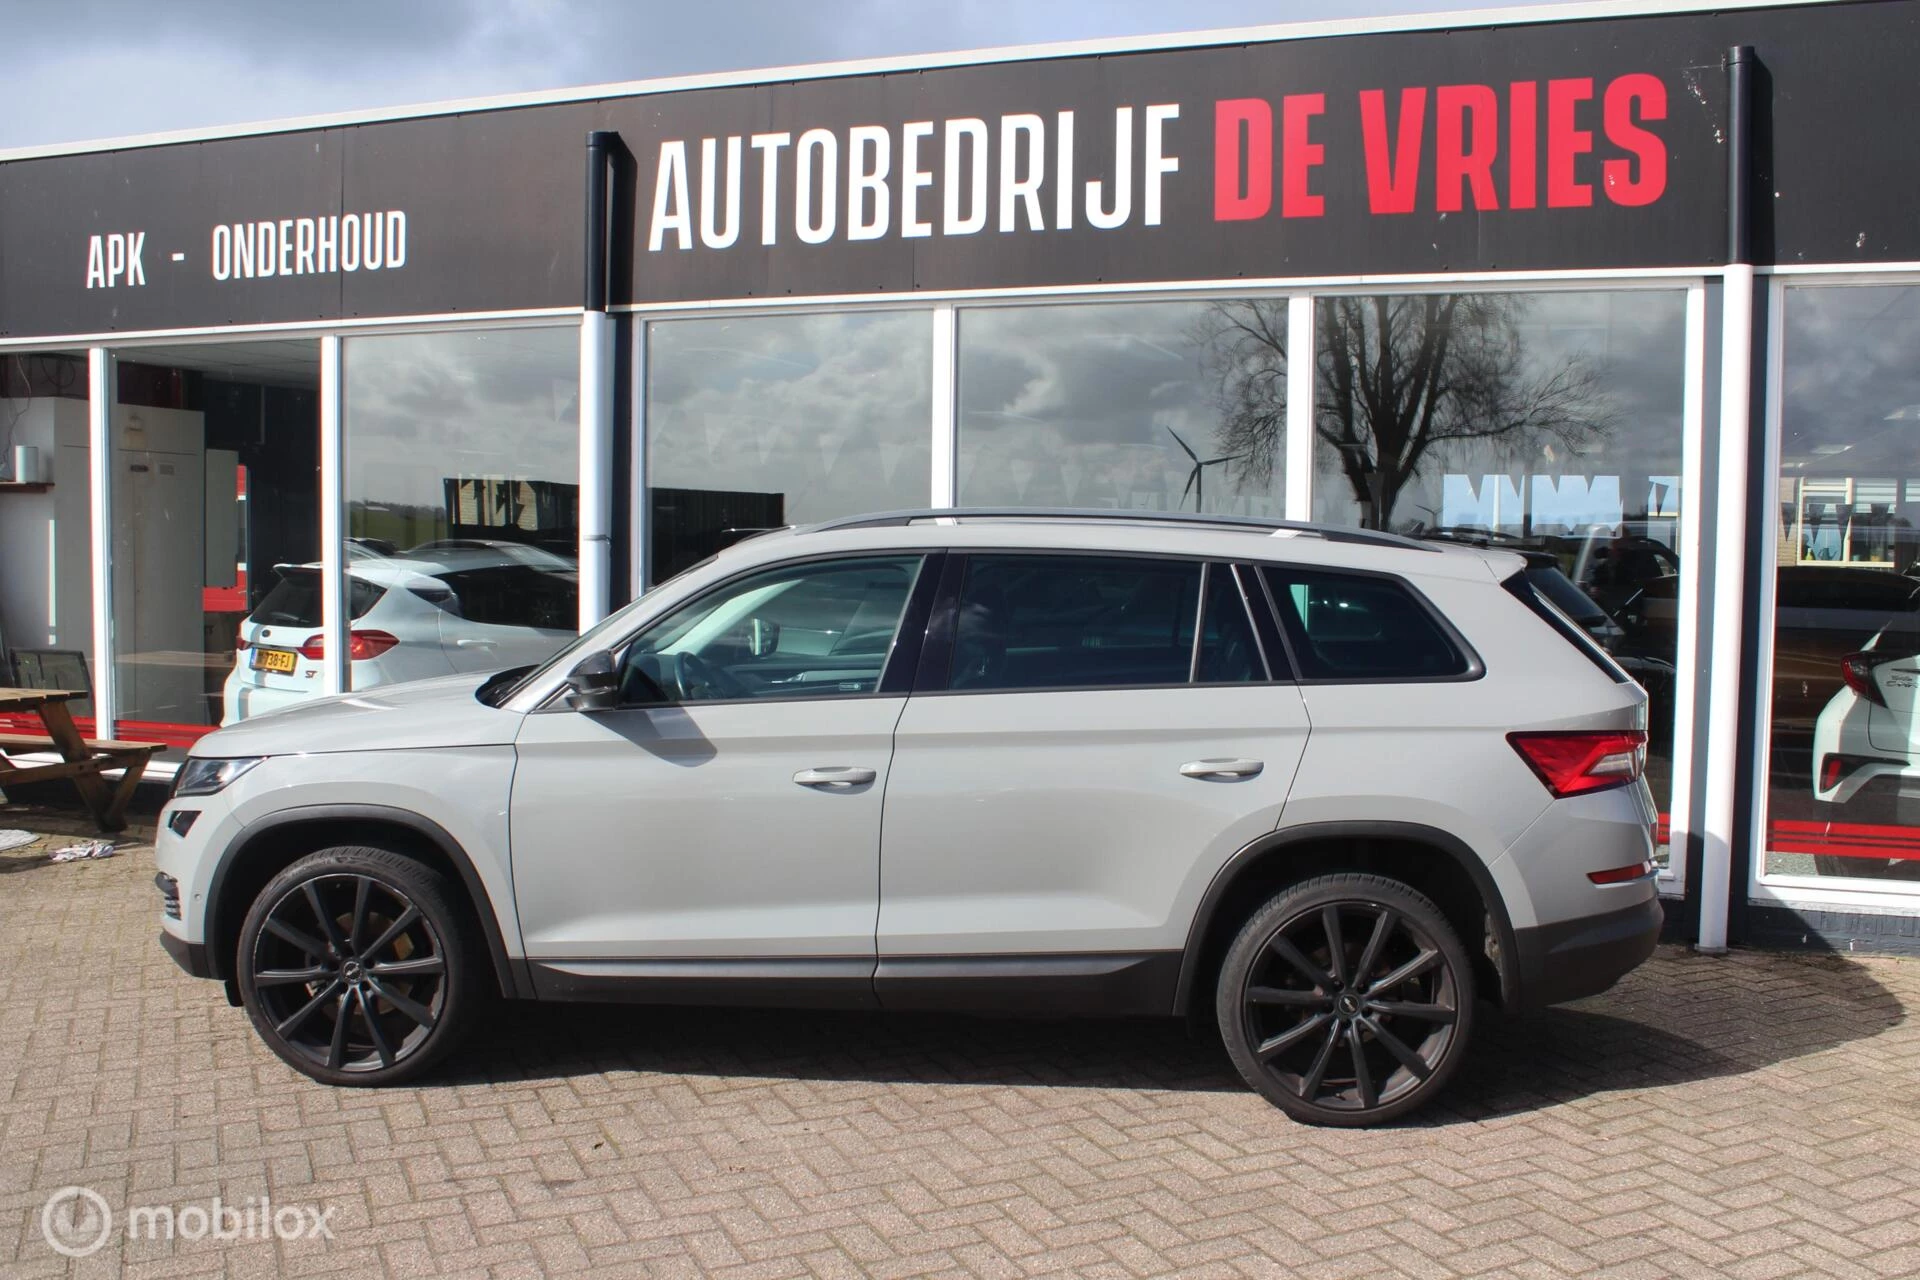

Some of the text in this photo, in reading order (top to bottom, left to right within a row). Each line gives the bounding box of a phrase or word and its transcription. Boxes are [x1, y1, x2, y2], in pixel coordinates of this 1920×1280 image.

[648, 73, 1669, 252] AUTOBEDRIJF DE VRIES
[86, 210, 406, 289] APK - ONDERHOUD
